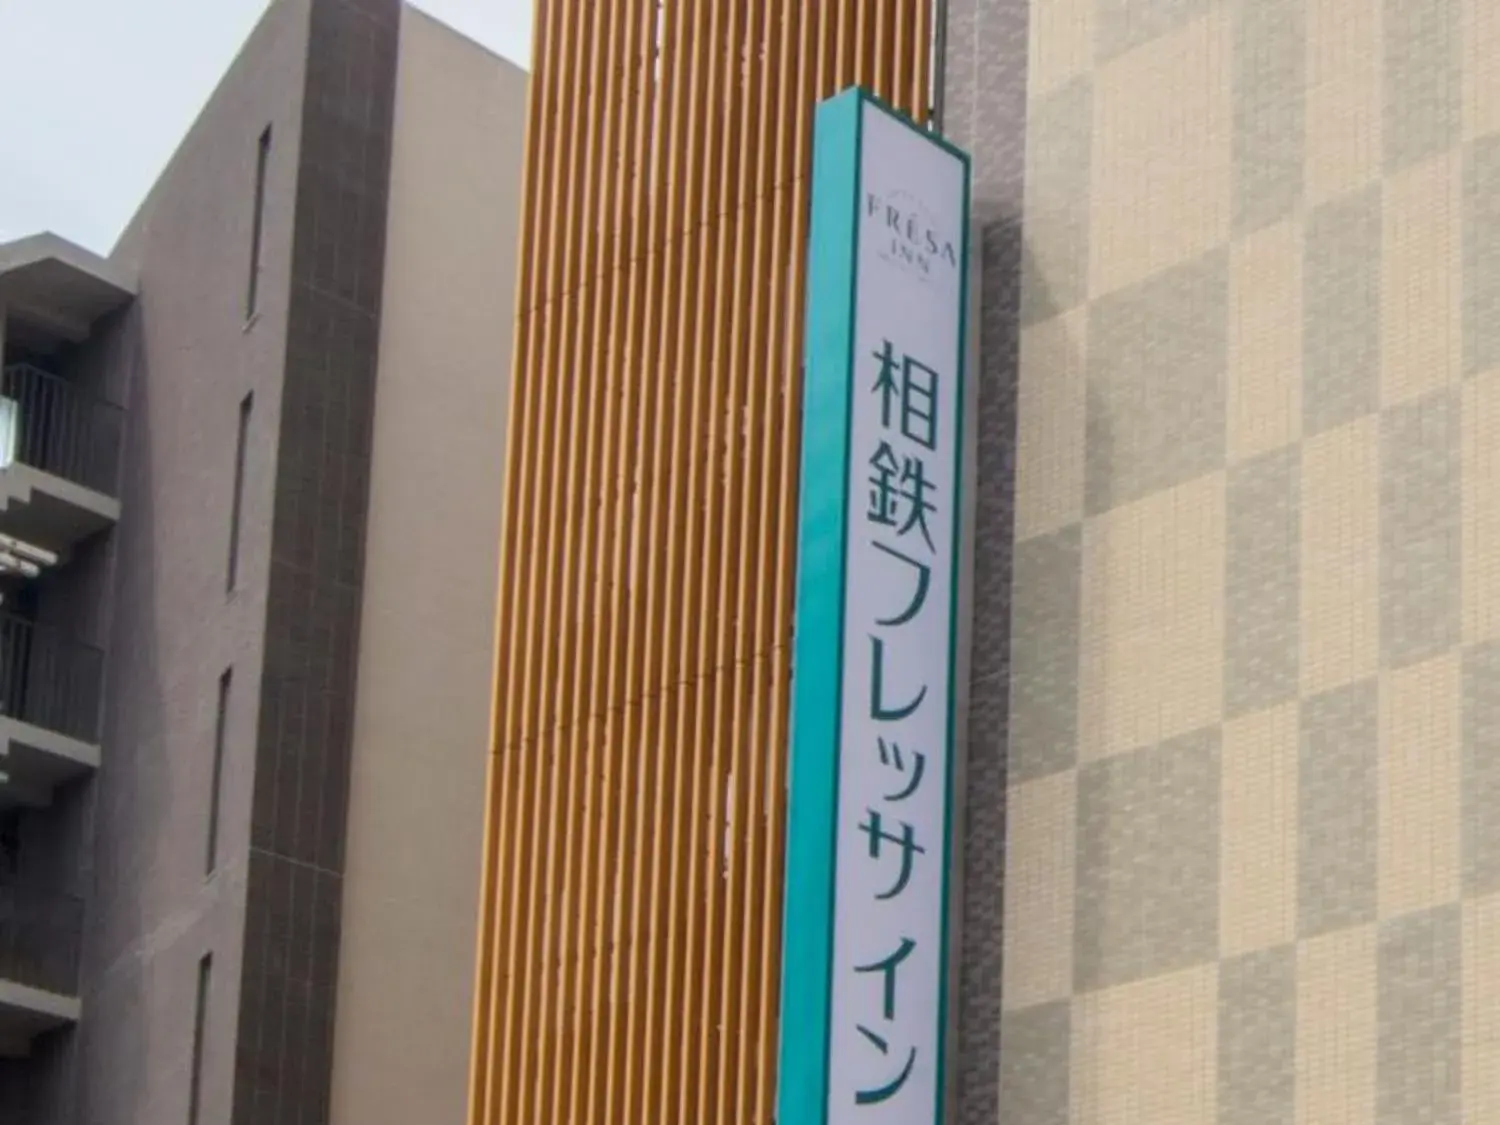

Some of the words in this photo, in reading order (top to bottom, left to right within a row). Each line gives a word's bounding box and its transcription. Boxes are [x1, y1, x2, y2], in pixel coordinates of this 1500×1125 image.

[866, 192, 957, 269] FRESA
[853, 339, 938, 1106] 相鉄フレッサイン
